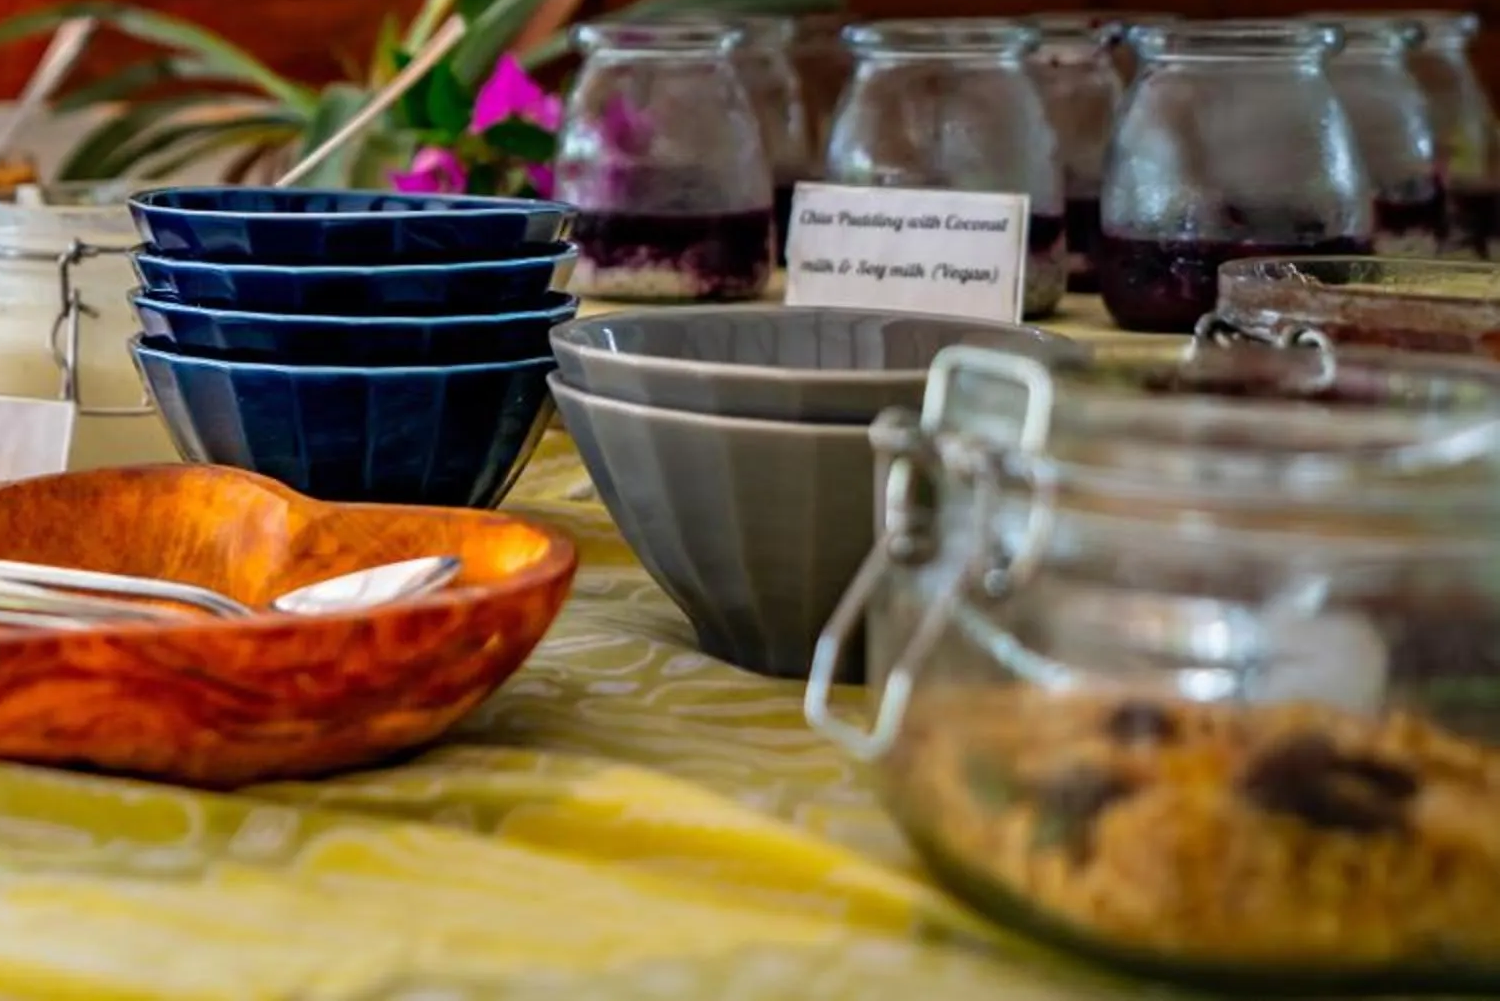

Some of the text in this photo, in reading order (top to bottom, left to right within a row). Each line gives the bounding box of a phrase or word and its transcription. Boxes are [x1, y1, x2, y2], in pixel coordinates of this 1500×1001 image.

[838, 210, 903, 231] Pudding
[907, 213, 941, 230] with
[945, 213, 1009, 232] Coconut
[801, 258, 999, 284] milk & Soy milk (Vegan)
